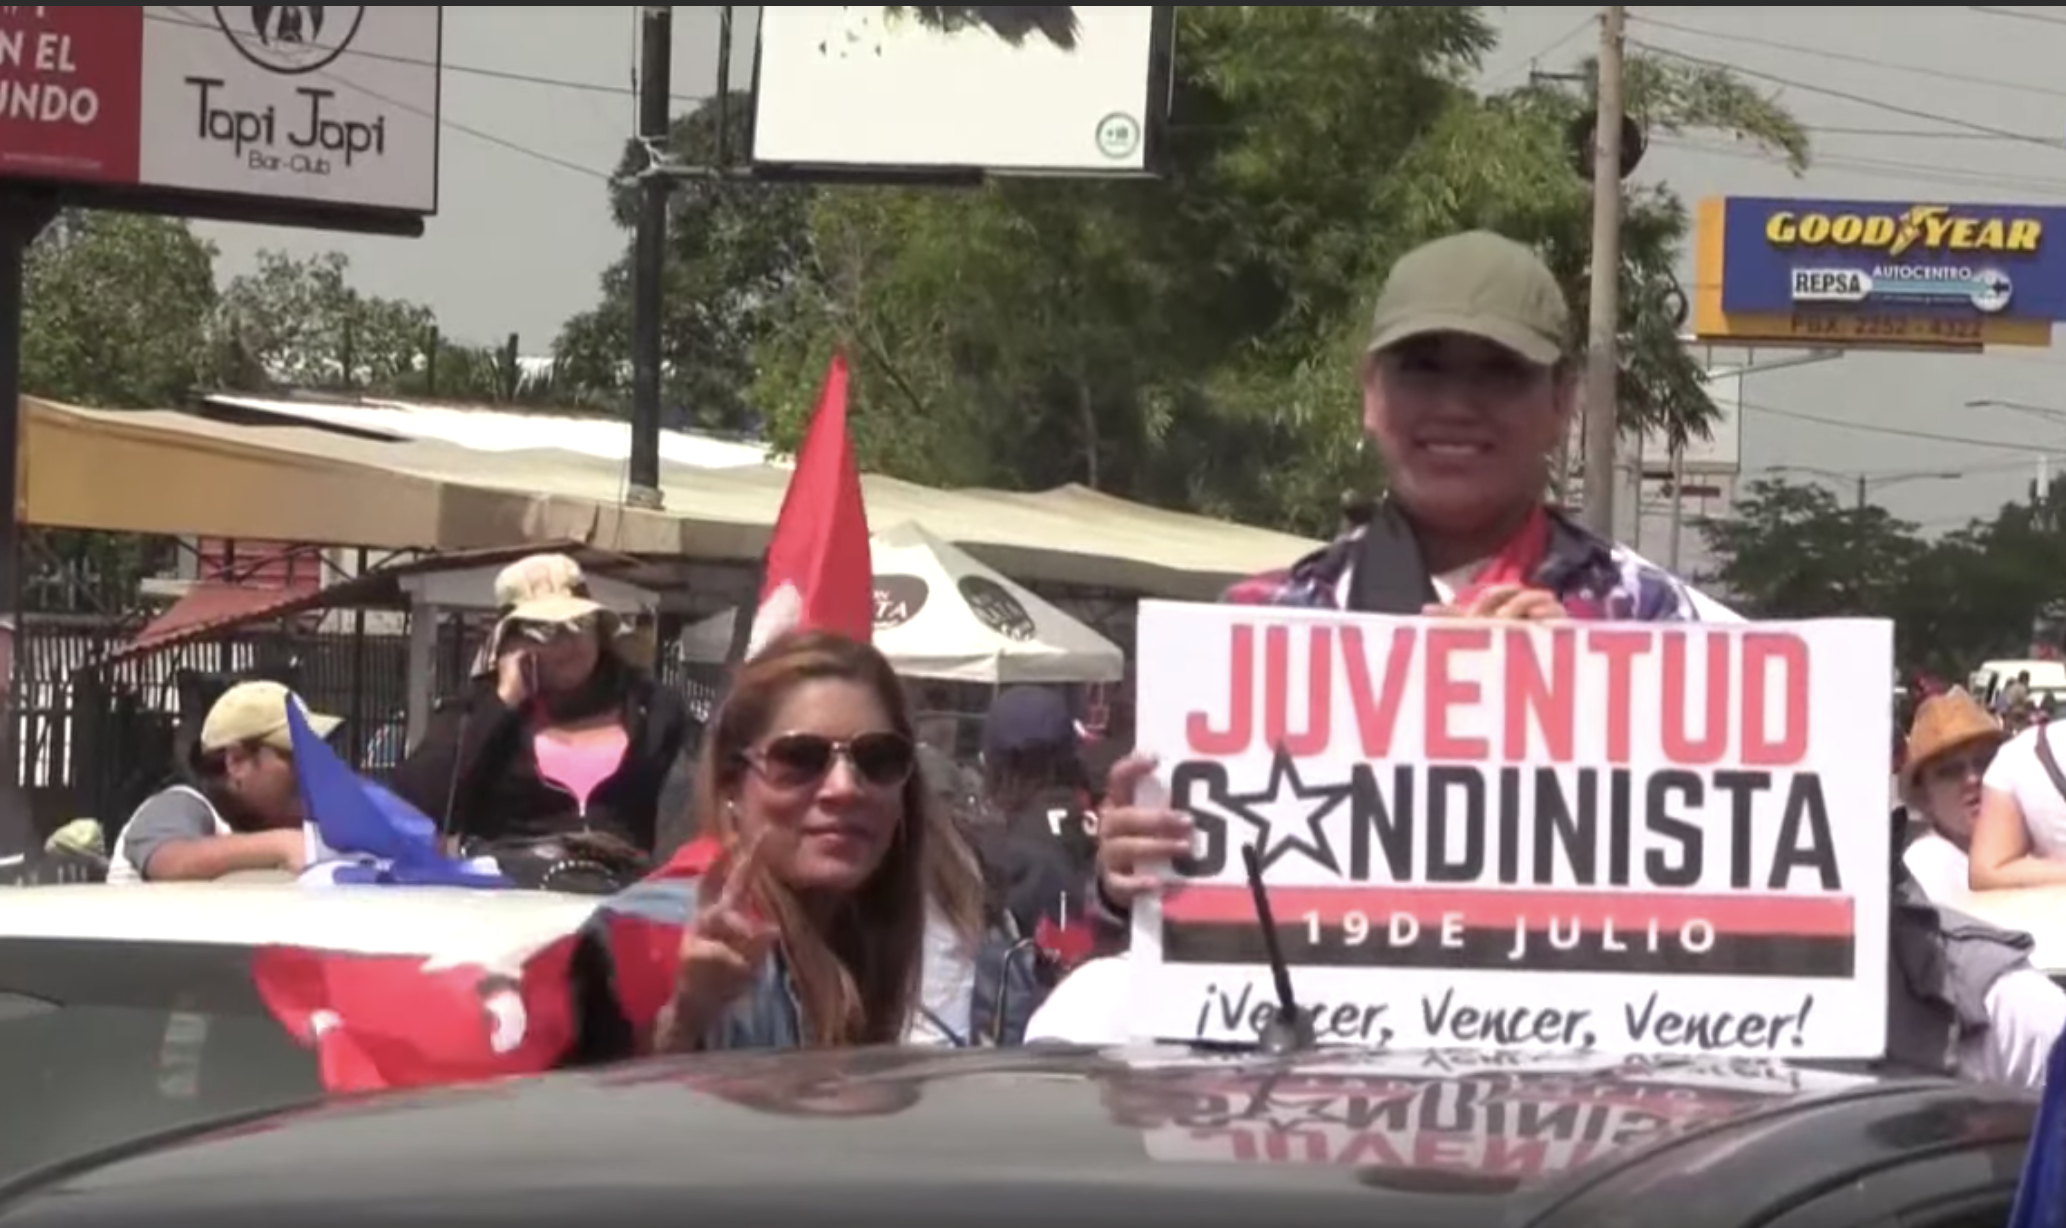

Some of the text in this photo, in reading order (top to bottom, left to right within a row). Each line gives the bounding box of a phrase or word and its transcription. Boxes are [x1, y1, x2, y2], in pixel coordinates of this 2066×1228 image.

[35, 33, 76, 72] EL
[184, 76, 385, 167] Tapi Japi
[1795, 272, 1862, 293] REPSA
[1872, 265, 1972, 280] AUTOCENTRO
[1185, 624, 1810, 766] JUVENTUD
[1507, 912, 1716, 961] JULIO
[1197, 982, 1814, 1050] ¡Vecer, Vencer, Vencer!
